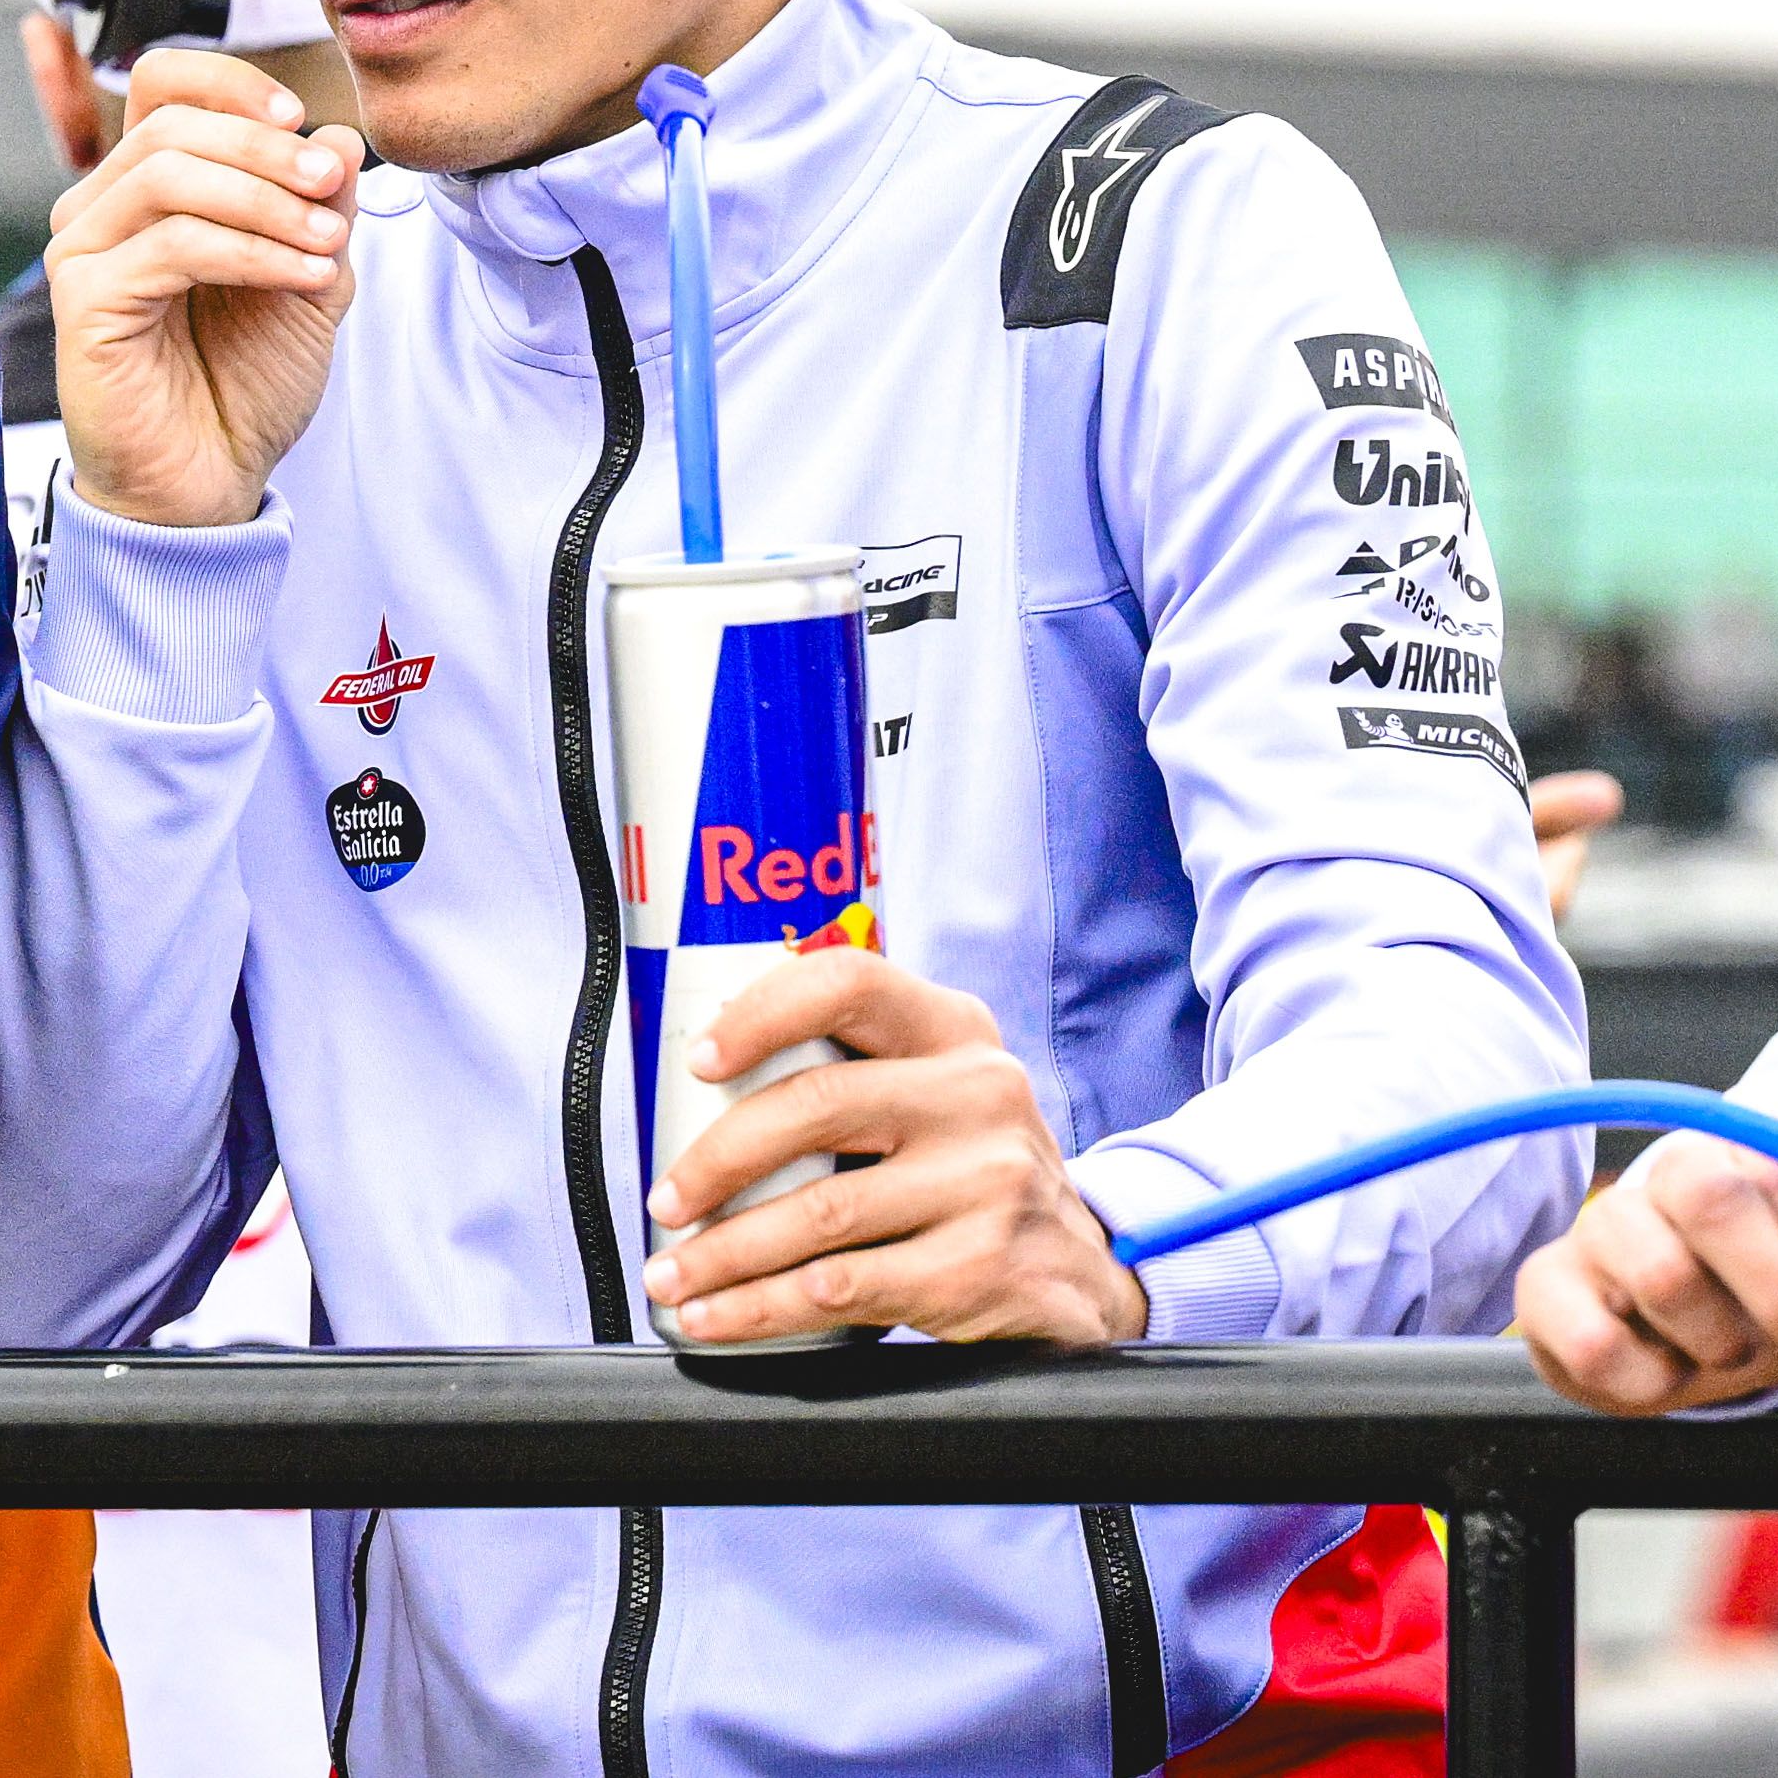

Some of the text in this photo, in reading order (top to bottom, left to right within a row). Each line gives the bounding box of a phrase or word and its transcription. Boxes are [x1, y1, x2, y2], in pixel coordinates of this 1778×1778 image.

[330, 662, 424, 699] FEDERAL OIL
[333, 800, 403, 833] Estrella
[340, 829, 402, 862] Galicia
[699, 811, 857, 906] Red
